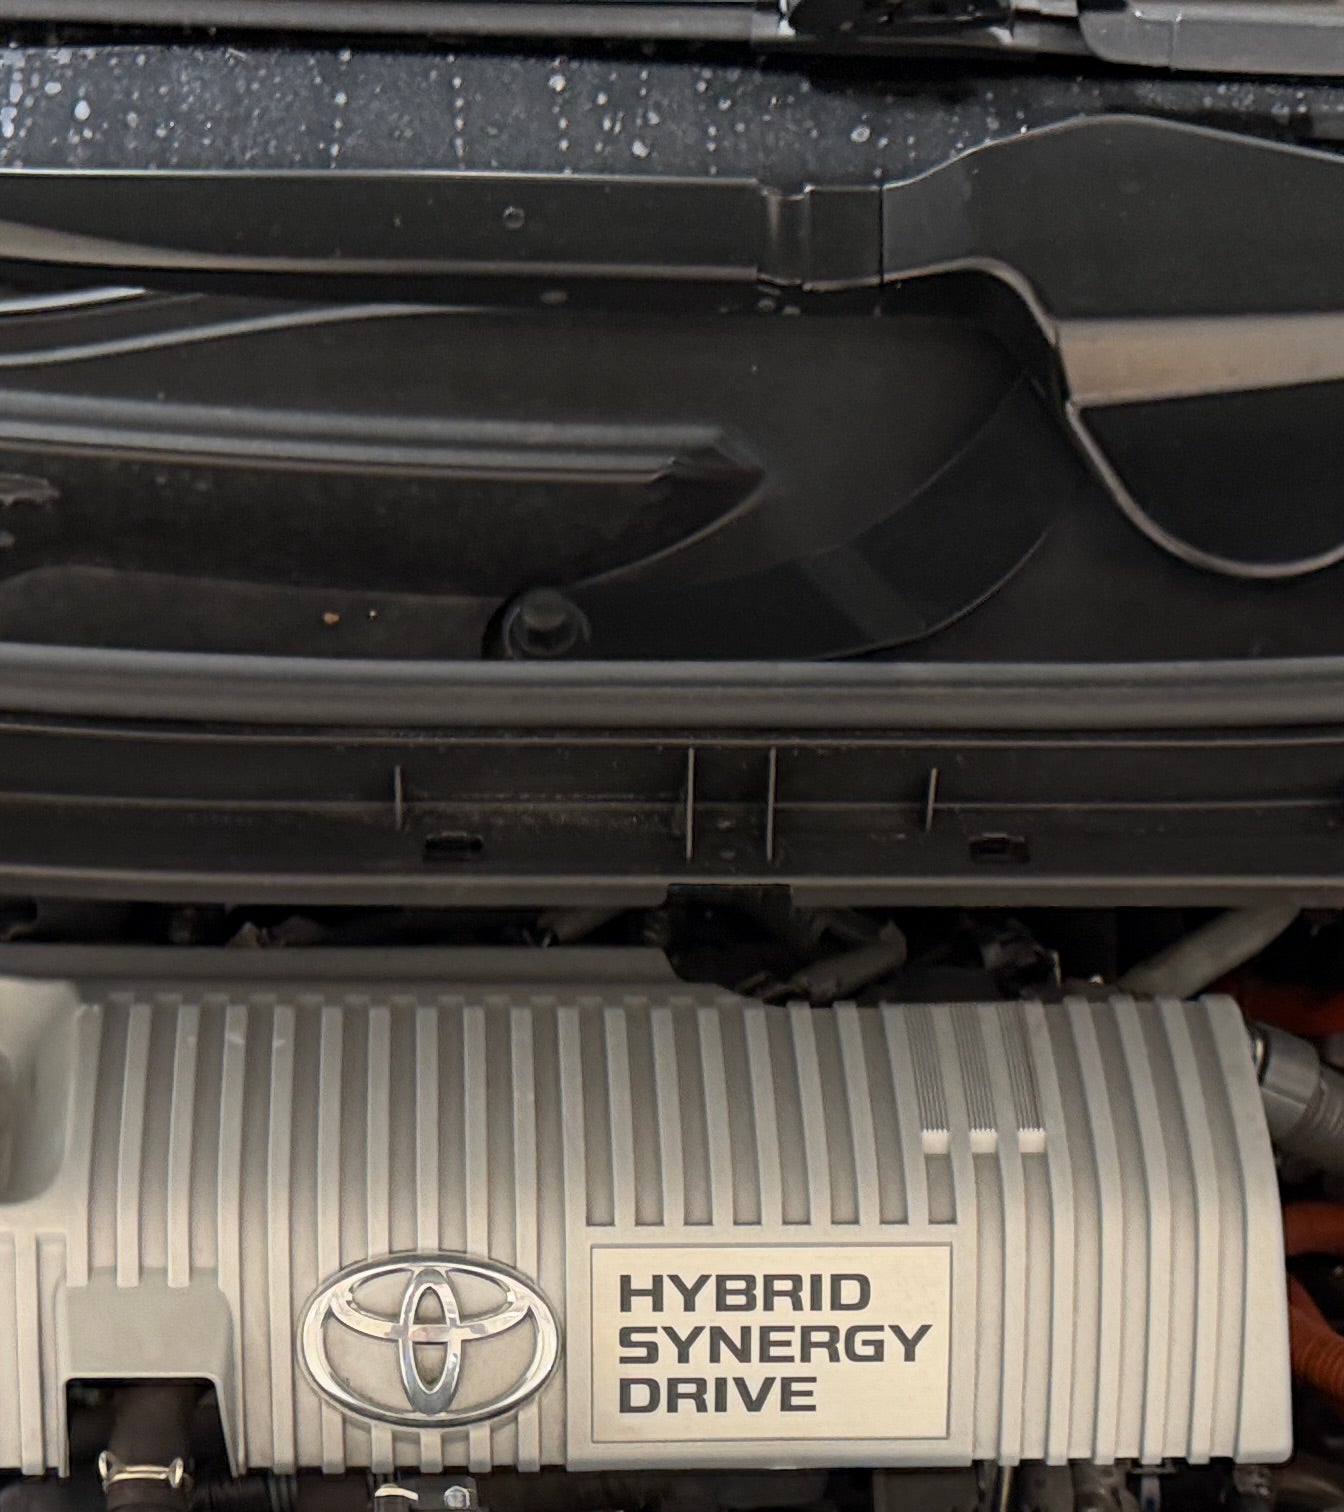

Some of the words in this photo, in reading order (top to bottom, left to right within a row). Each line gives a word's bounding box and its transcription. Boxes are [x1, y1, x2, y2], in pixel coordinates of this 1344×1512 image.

[619, 1273, 872, 1313] HYBRID
[618, 1323, 934, 1365] SYNERGY
[618, 1376, 818, 1414] DRIVE
